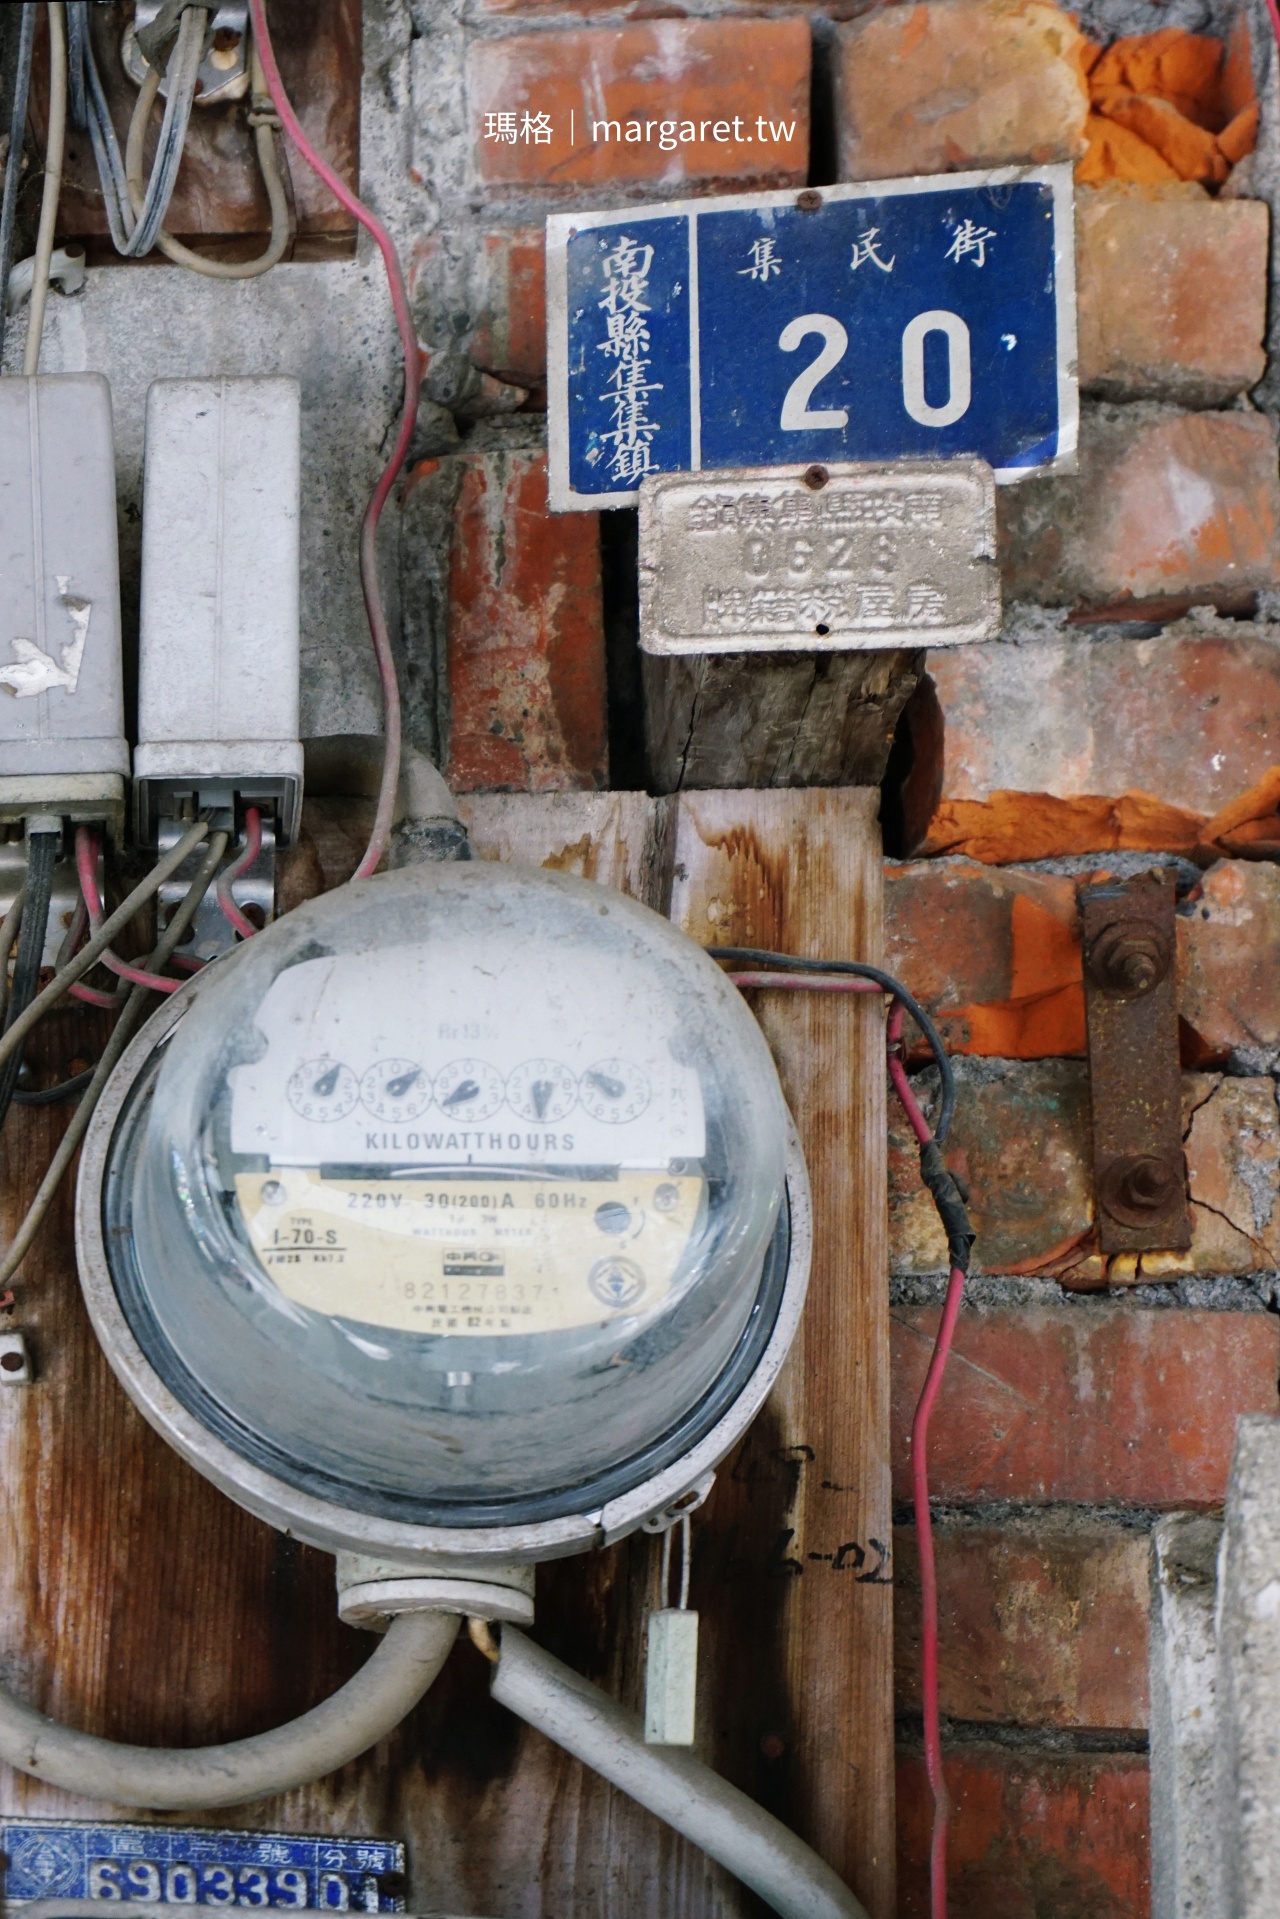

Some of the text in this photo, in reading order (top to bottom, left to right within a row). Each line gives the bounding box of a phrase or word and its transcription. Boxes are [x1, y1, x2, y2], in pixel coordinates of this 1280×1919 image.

[736, 218, 997, 282] 集民街
[597, 235, 664, 484] 南投縣集集鎮
[778, 309, 971, 431] 20
[365, 1132, 575, 1150] KILOWATTHOURS
[347, 1192, 402, 1209] 220V
[533, 1192, 588, 1209] 60Hz
[412, 1227, 531, 1237] WATTHOUR METER
[404, 1281, 544, 1301] 82127837
